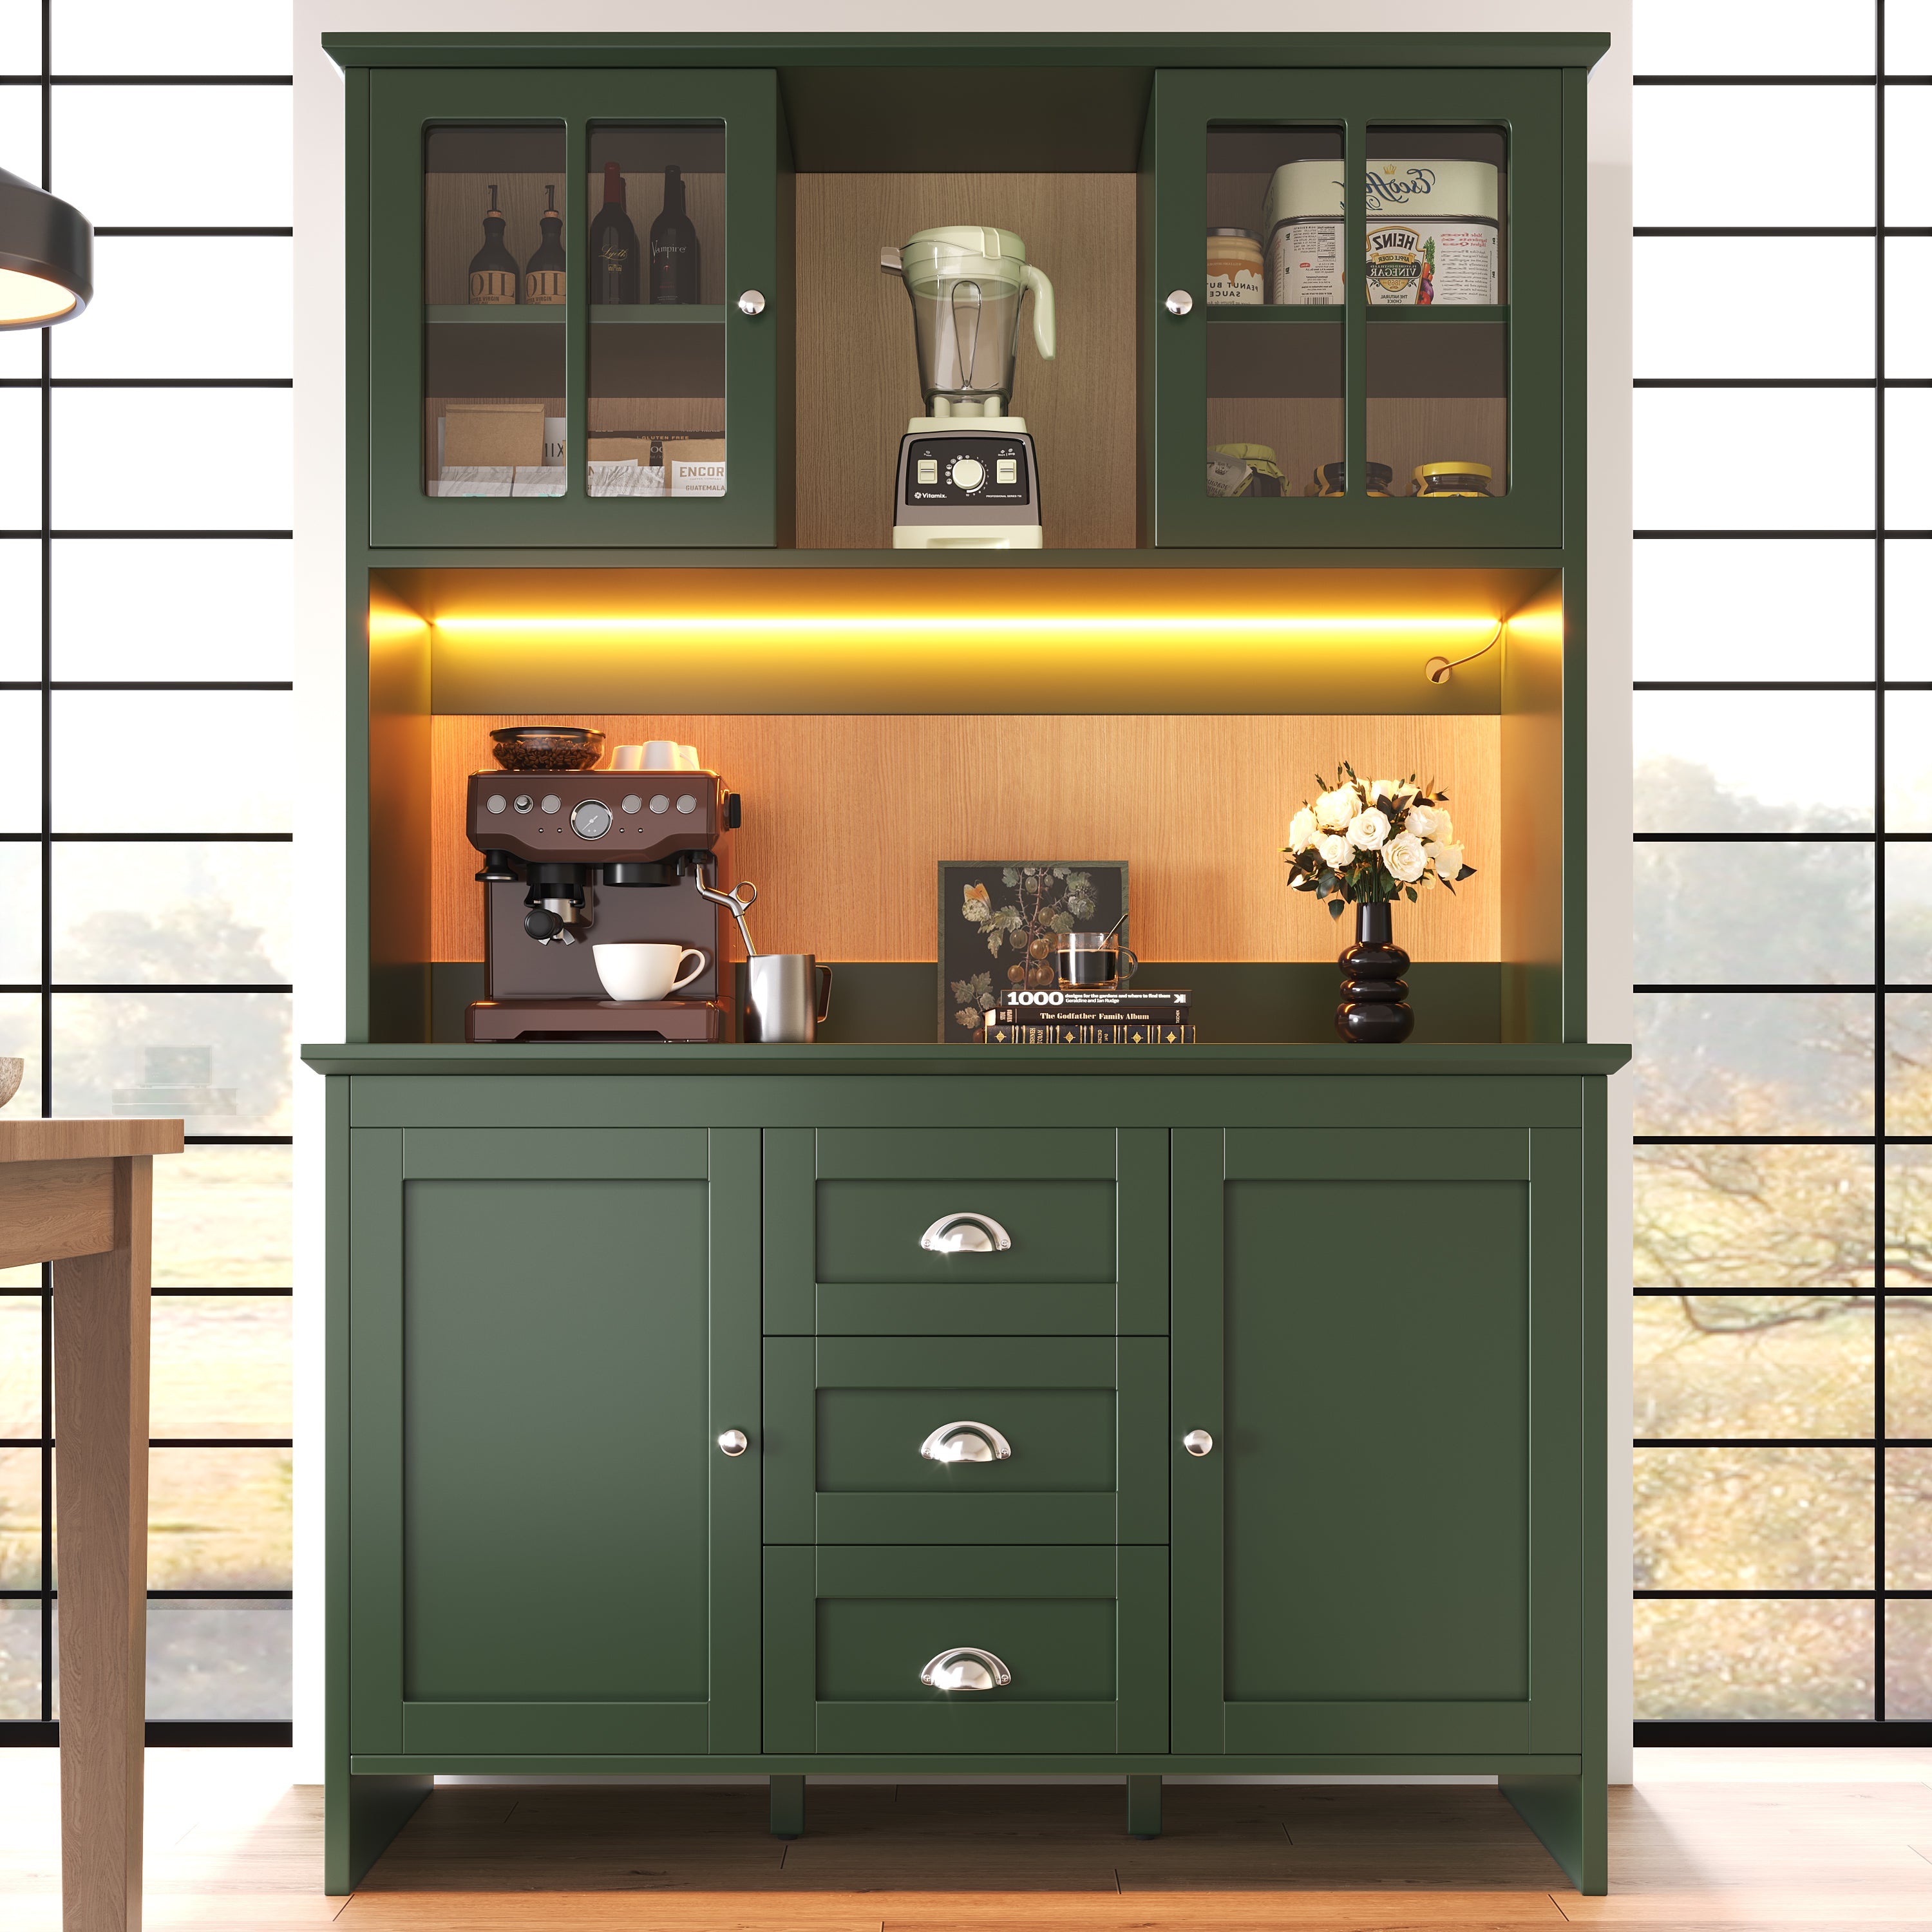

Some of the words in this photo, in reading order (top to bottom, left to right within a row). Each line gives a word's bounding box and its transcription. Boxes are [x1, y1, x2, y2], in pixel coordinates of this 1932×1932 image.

[652, 240, 687, 259] Vampire
[471, 272, 515, 298] OIL
[526, 272, 566, 298] OIL
[680, 467, 724, 477] ENCOR
[1007, 991, 1064, 1005] 1000
[1099, 1012, 1124, 1021] Family
